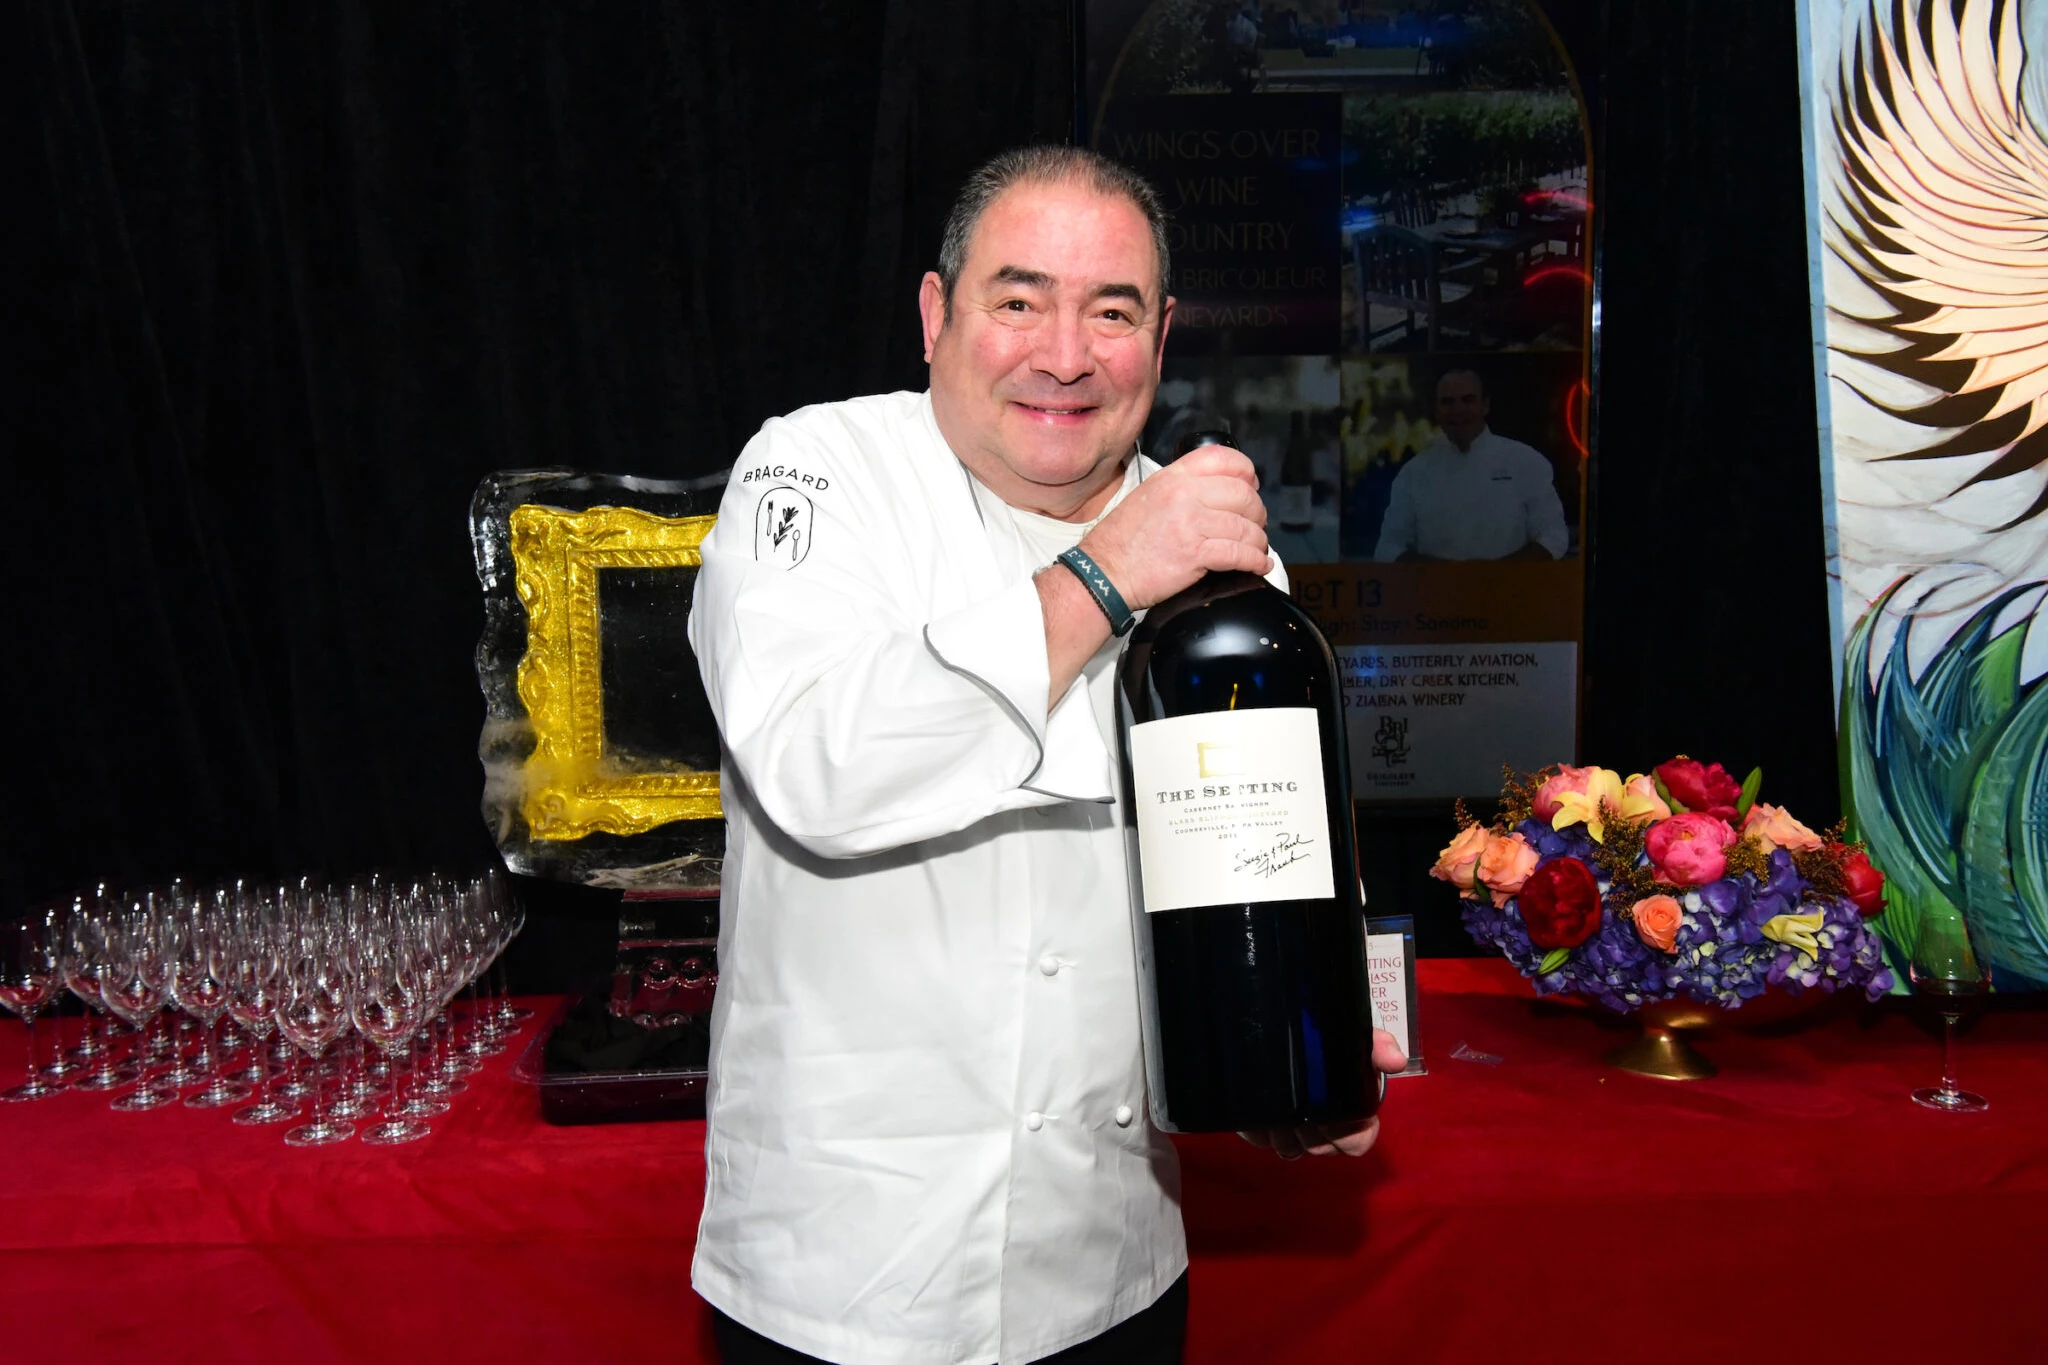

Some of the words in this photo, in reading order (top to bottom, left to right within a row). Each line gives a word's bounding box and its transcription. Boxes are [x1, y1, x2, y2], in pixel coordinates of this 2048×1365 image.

[1113, 129, 1222, 160] WINGS
[1230, 128, 1321, 159] OVER
[1175, 176, 1259, 206] WINE
[1169, 221, 1296, 251] OUNTRY
[1183, 266, 1326, 291] BRICOLEUR
[1173, 304, 1289, 328] NEYARDS
[742, 465, 829, 491] BRAGARD
[1356, 578, 1383, 608] 13
[1319, 616, 1356, 636] ight
[1362, 614, 1399, 633] Stay
[1338, 656, 1388, 669] YARDS,
[1392, 655, 1465, 669] BUTTERFLY
[1469, 653, 1539, 668] AVIATION,
[1380, 675, 1406, 687] DRY
[1411, 674, 1454, 687] CREEK
[1458, 673, 1519, 687] KITCHEN,
[1412, 692, 1465, 706] WINERY
[1157, 789, 1196, 804] THE
[1225, 801, 1270, 809] SAVIGNON
[1367, 957, 1402, 970] TTING
[1370, 972, 1397, 985] LASS
